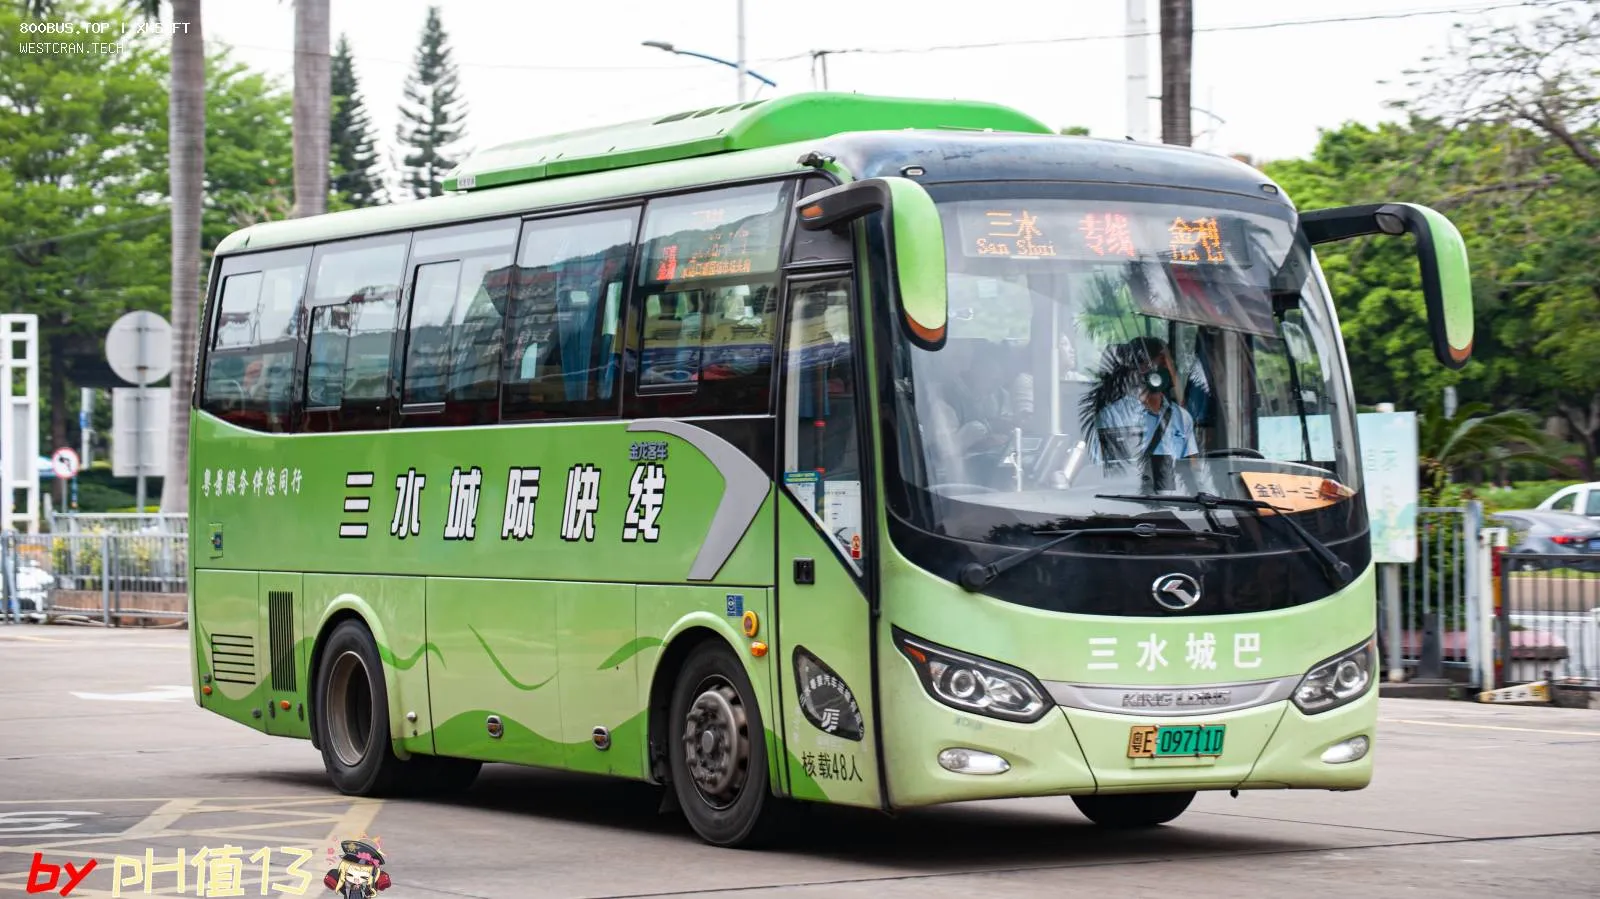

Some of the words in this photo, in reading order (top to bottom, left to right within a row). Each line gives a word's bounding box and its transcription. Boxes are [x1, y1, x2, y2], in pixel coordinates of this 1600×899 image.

[985, 210, 1042, 239] 三水
[976, 238, 1010, 256] San
[1015, 238, 1057, 257] Shui
[628, 441, 668, 461] 金龙客车
[339, 462, 667, 542] 三水城际快线
[1087, 632, 1263, 672] 三水城巴
[1121, 692, 1173, 707] KING
[1175, 689, 1232, 706] LONG
[801, 750, 863, 782] 核载48人
